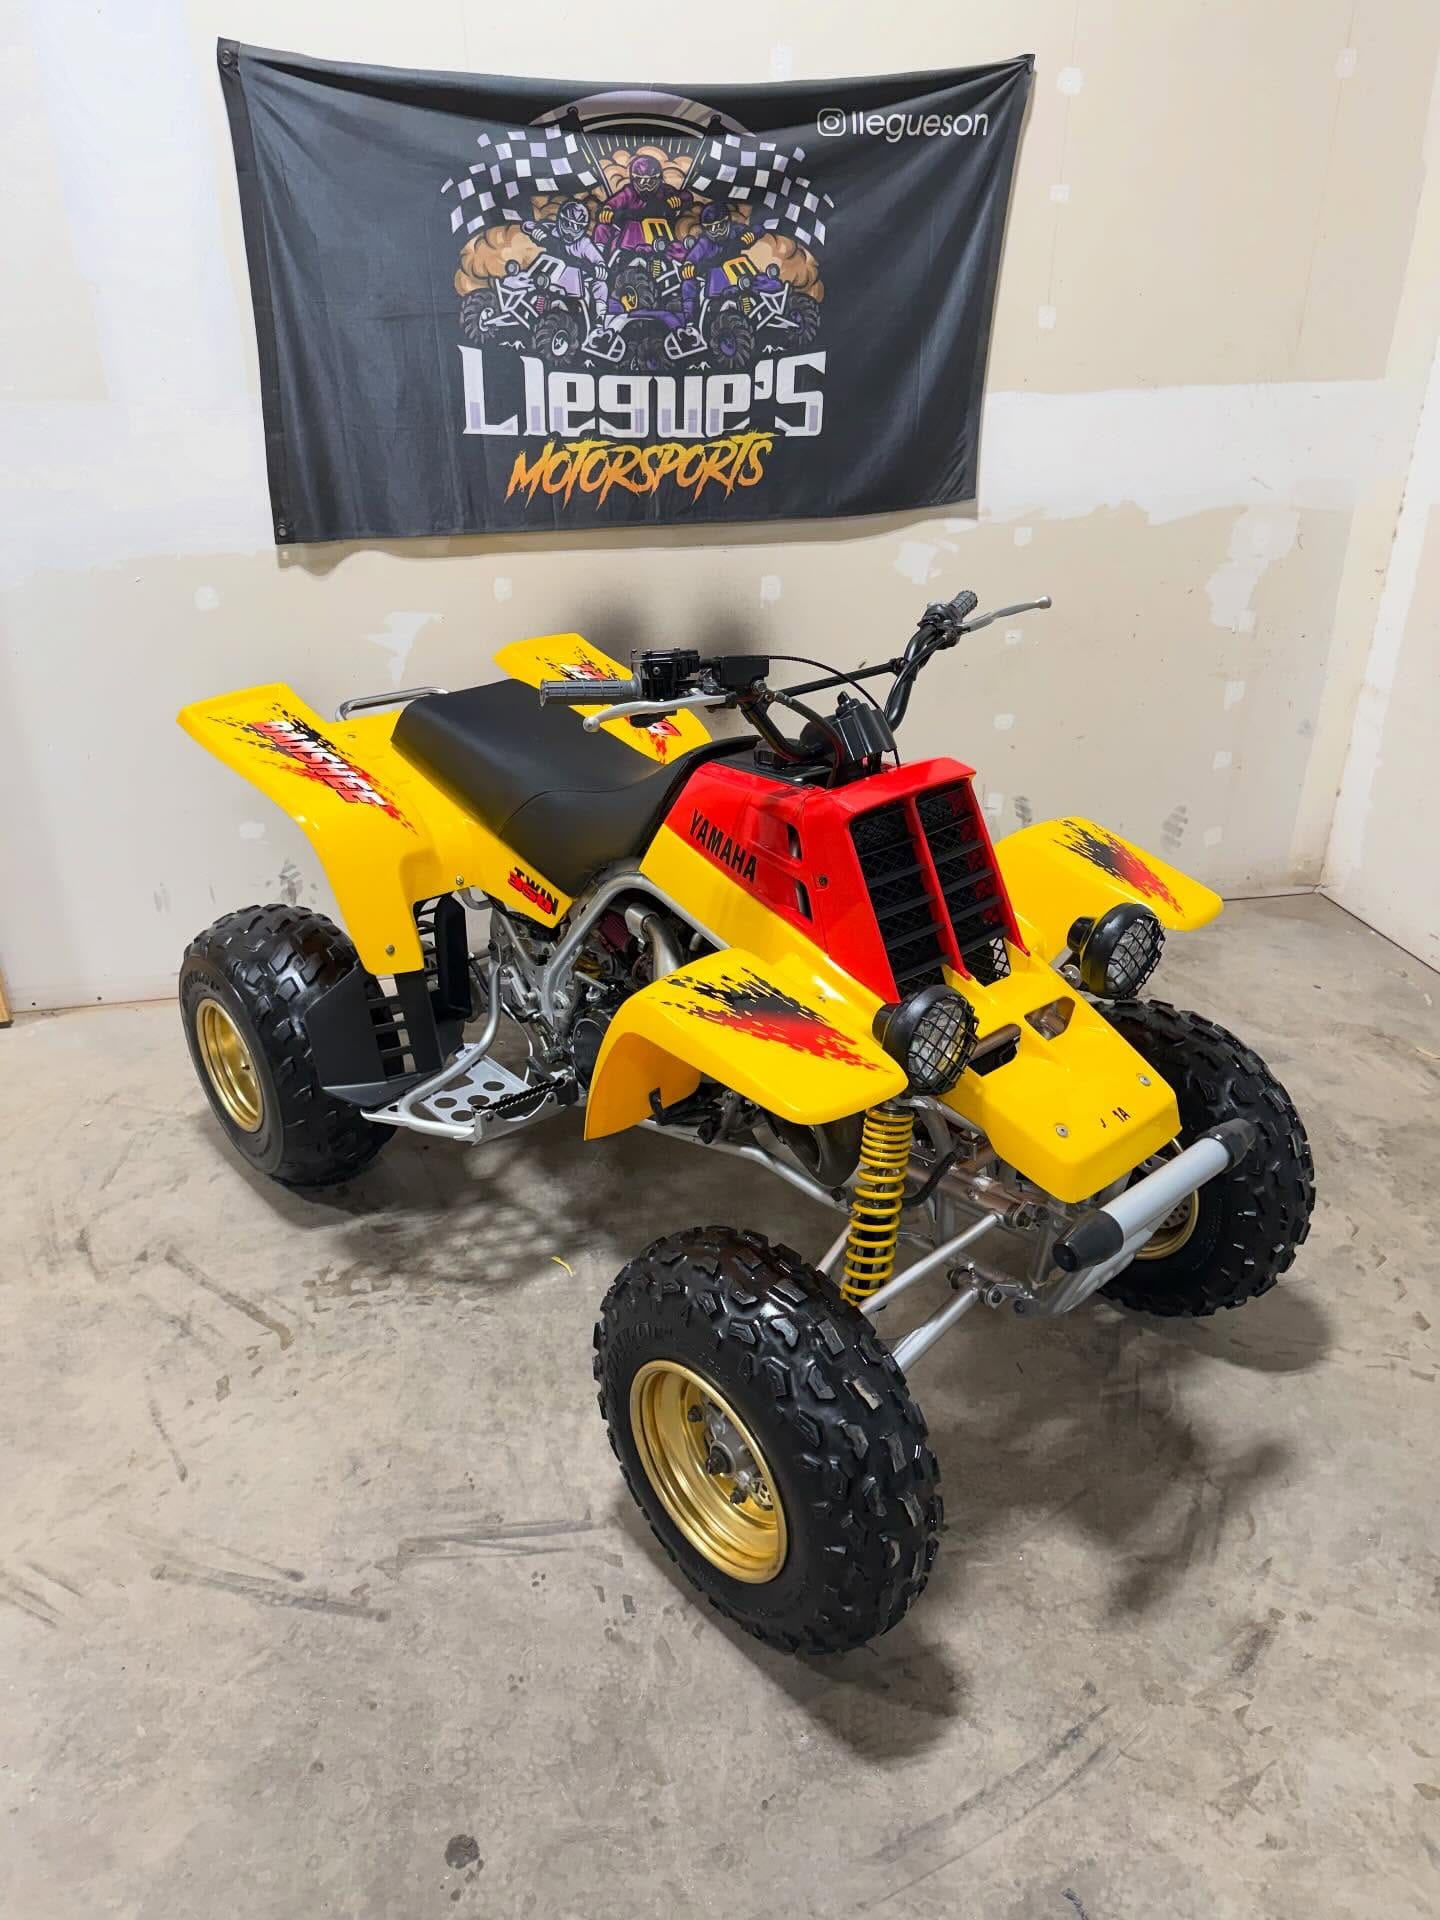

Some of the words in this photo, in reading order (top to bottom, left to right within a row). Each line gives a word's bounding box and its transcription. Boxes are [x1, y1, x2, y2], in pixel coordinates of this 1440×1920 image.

[852, 111, 988, 143] llegueson
[503, 429, 780, 511] MOTORSPORTS
[251, 721, 386, 804] BANSHEE
[690, 808, 757, 883] YAMAHA
[514, 866, 559, 916] TWIN
